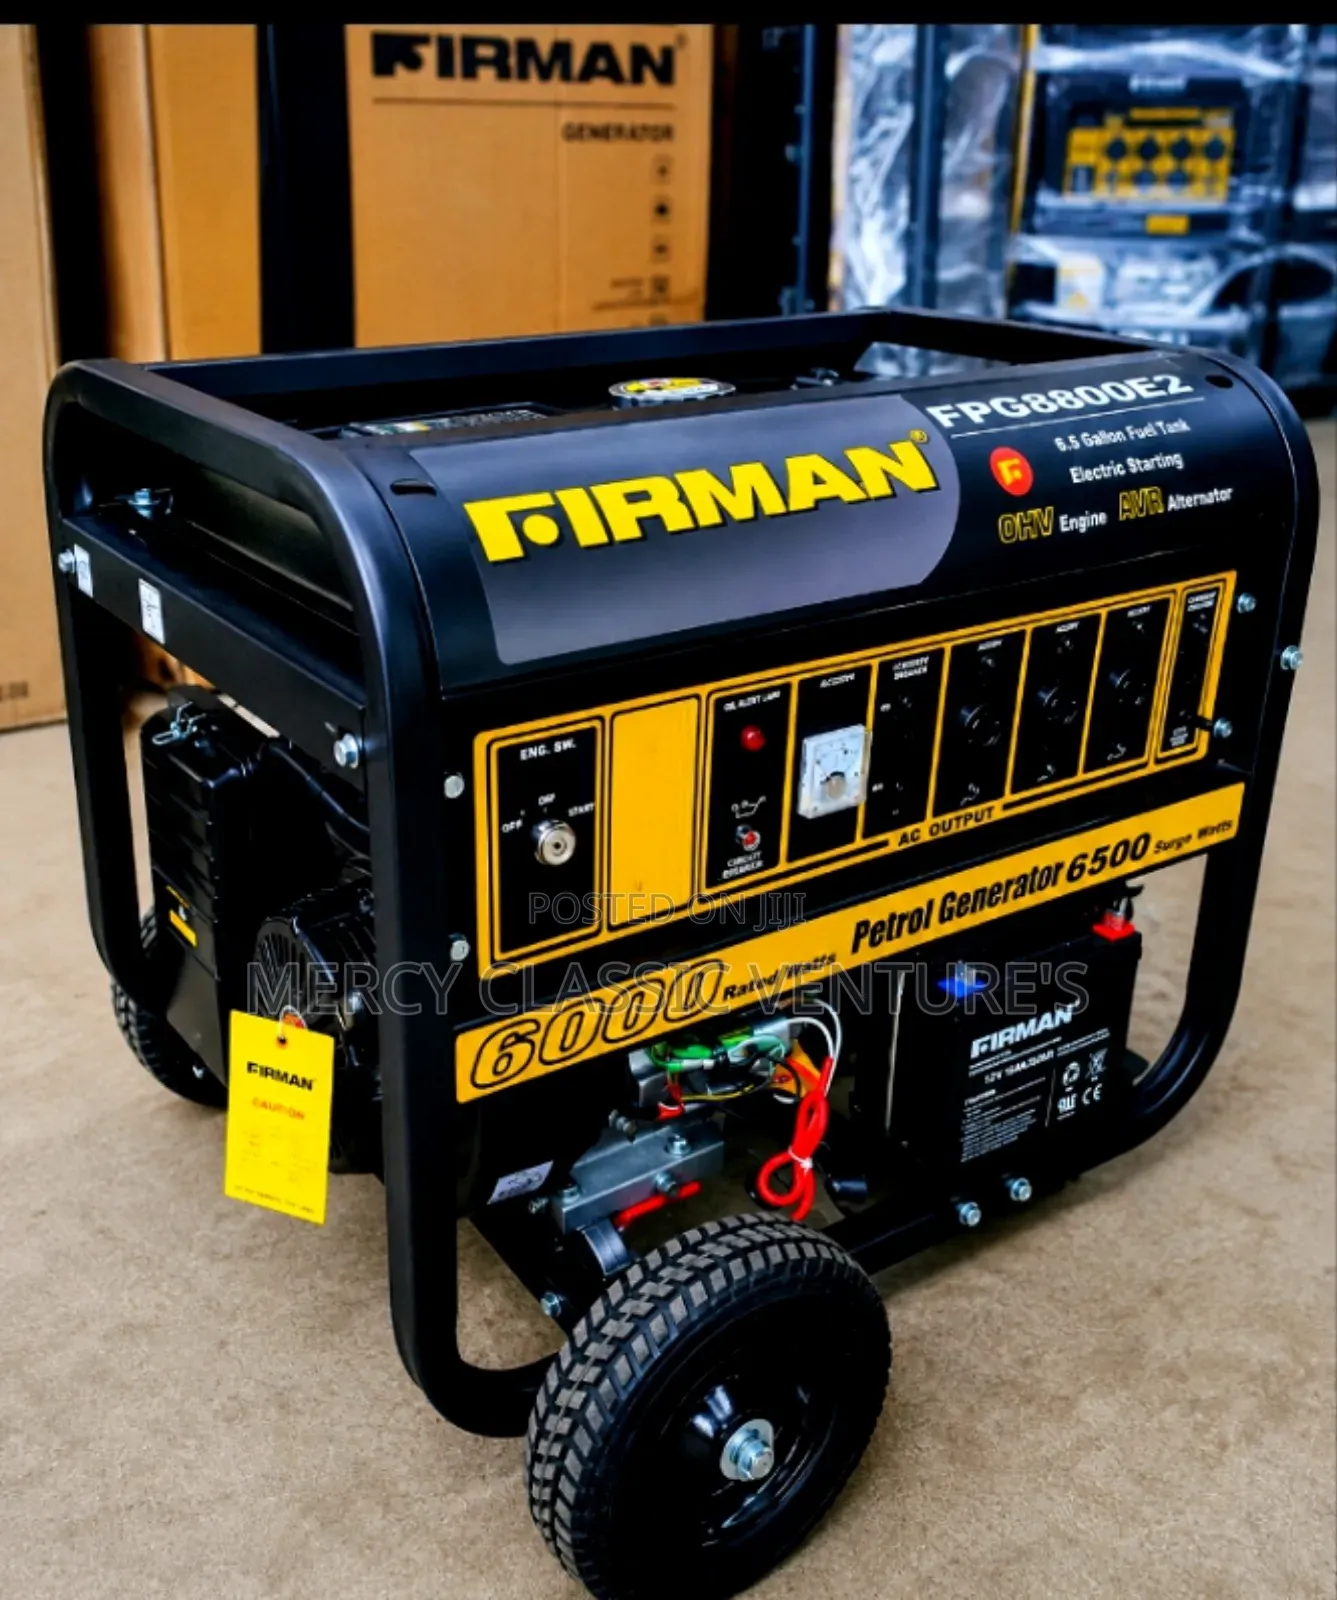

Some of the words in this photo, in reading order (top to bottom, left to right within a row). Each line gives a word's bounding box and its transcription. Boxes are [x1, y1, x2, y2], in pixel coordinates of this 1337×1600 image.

[371, 31, 676, 86] FIRMAN
[562, 121, 675, 143] GENERATOR
[925, 374, 1195, 428] FPG8800E2
[1055, 435, 1081, 453] 6.5
[1082, 430, 1127, 449] Gallon
[1128, 424, 1157, 441] Fuel
[1157, 417, 1191, 437] Tank
[1069, 464, 1126, 484] Electric
[1127, 452, 1185, 475] Starting
[463, 439, 940, 564] FIRMAN
[1118, 486, 1165, 521] AVR
[1167, 486, 1234, 512] Alternator
[998, 506, 1054, 544] OHV
[1059, 510, 1108, 534] Engine
[502, 819, 523, 833] OFF
[898, 827, 921, 846] AC
[928, 806, 995, 838] OUTPUT
[851, 899, 934, 954] Petrol
[939, 859, 1065, 924] Generator
[1066, 832, 1152, 883] 6500
[1153, 834, 1193, 856] Surge
[1197, 820, 1234, 840] Watts
[470, 959, 725, 1090] 6000
[723, 973, 779, 1002] Rated
[783, 953, 837, 982] Watts
[970, 1003, 1076, 1059] FIRMAN
[247, 1061, 314, 1091] FIRMAN
[252, 1096, 306, 1120] CAUTION
